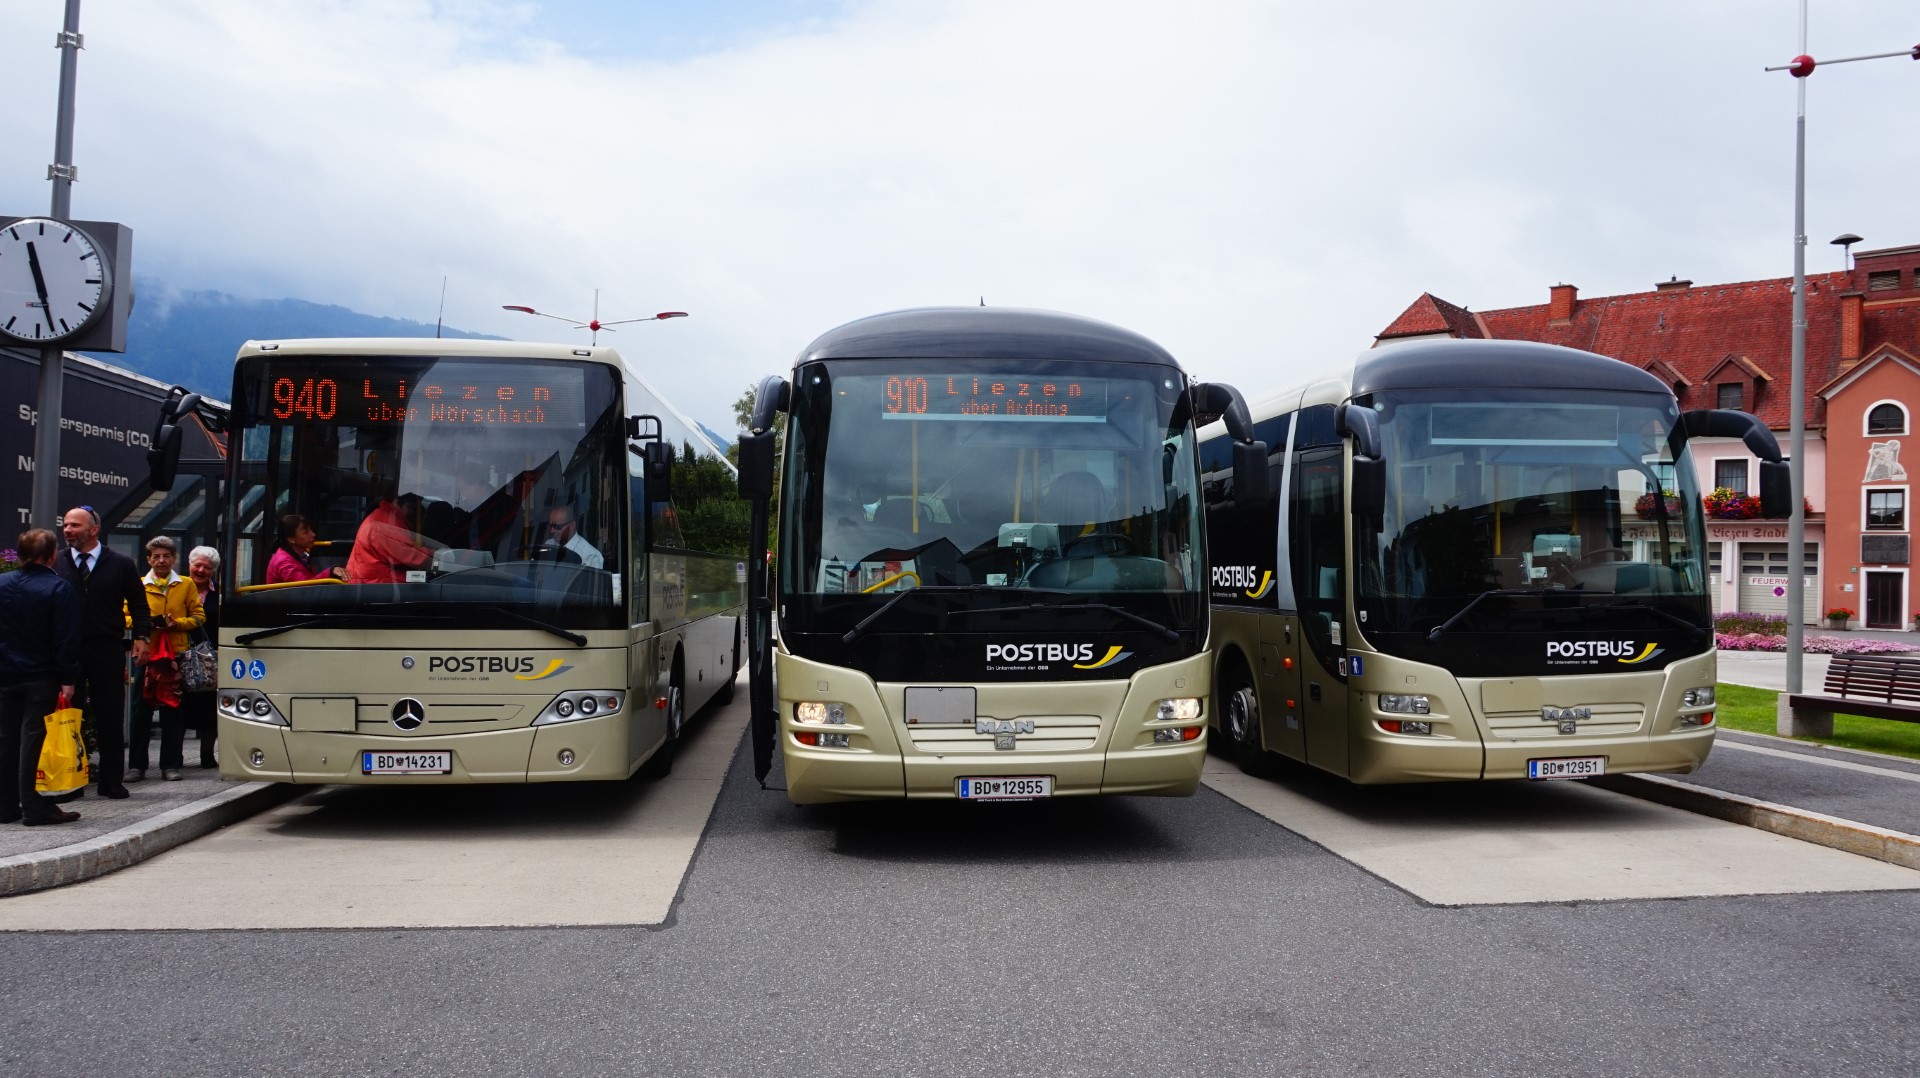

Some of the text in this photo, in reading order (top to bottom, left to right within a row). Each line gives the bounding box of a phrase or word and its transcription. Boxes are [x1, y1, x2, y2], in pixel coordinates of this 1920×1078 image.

[273, 377, 550, 420] 940 Liezen
[887, 376, 1082, 415] 910 Liezen
[431, 402, 544, 423] Wörschach
[1712, 527, 1749, 540] Liezen
[1752, 527, 1787, 538] Stadt
[1212, 565, 1257, 588] POSTBUS
[986, 643, 1094, 662] POSTBUS
[1546, 640, 1635, 657] POSTBUS
[429, 656, 535, 673] POSTBUS
[1542, 708, 1591, 721] MAN
[976, 721, 1034, 734] MAN
[378, 755, 395, 769] BD
[404, 755, 443, 769] 14231
[1542, 762, 1557, 775] BD
[1566, 761, 1598, 774] 12951
[974, 781, 992, 795] BD
[1002, 781, 1043, 795] 12955
